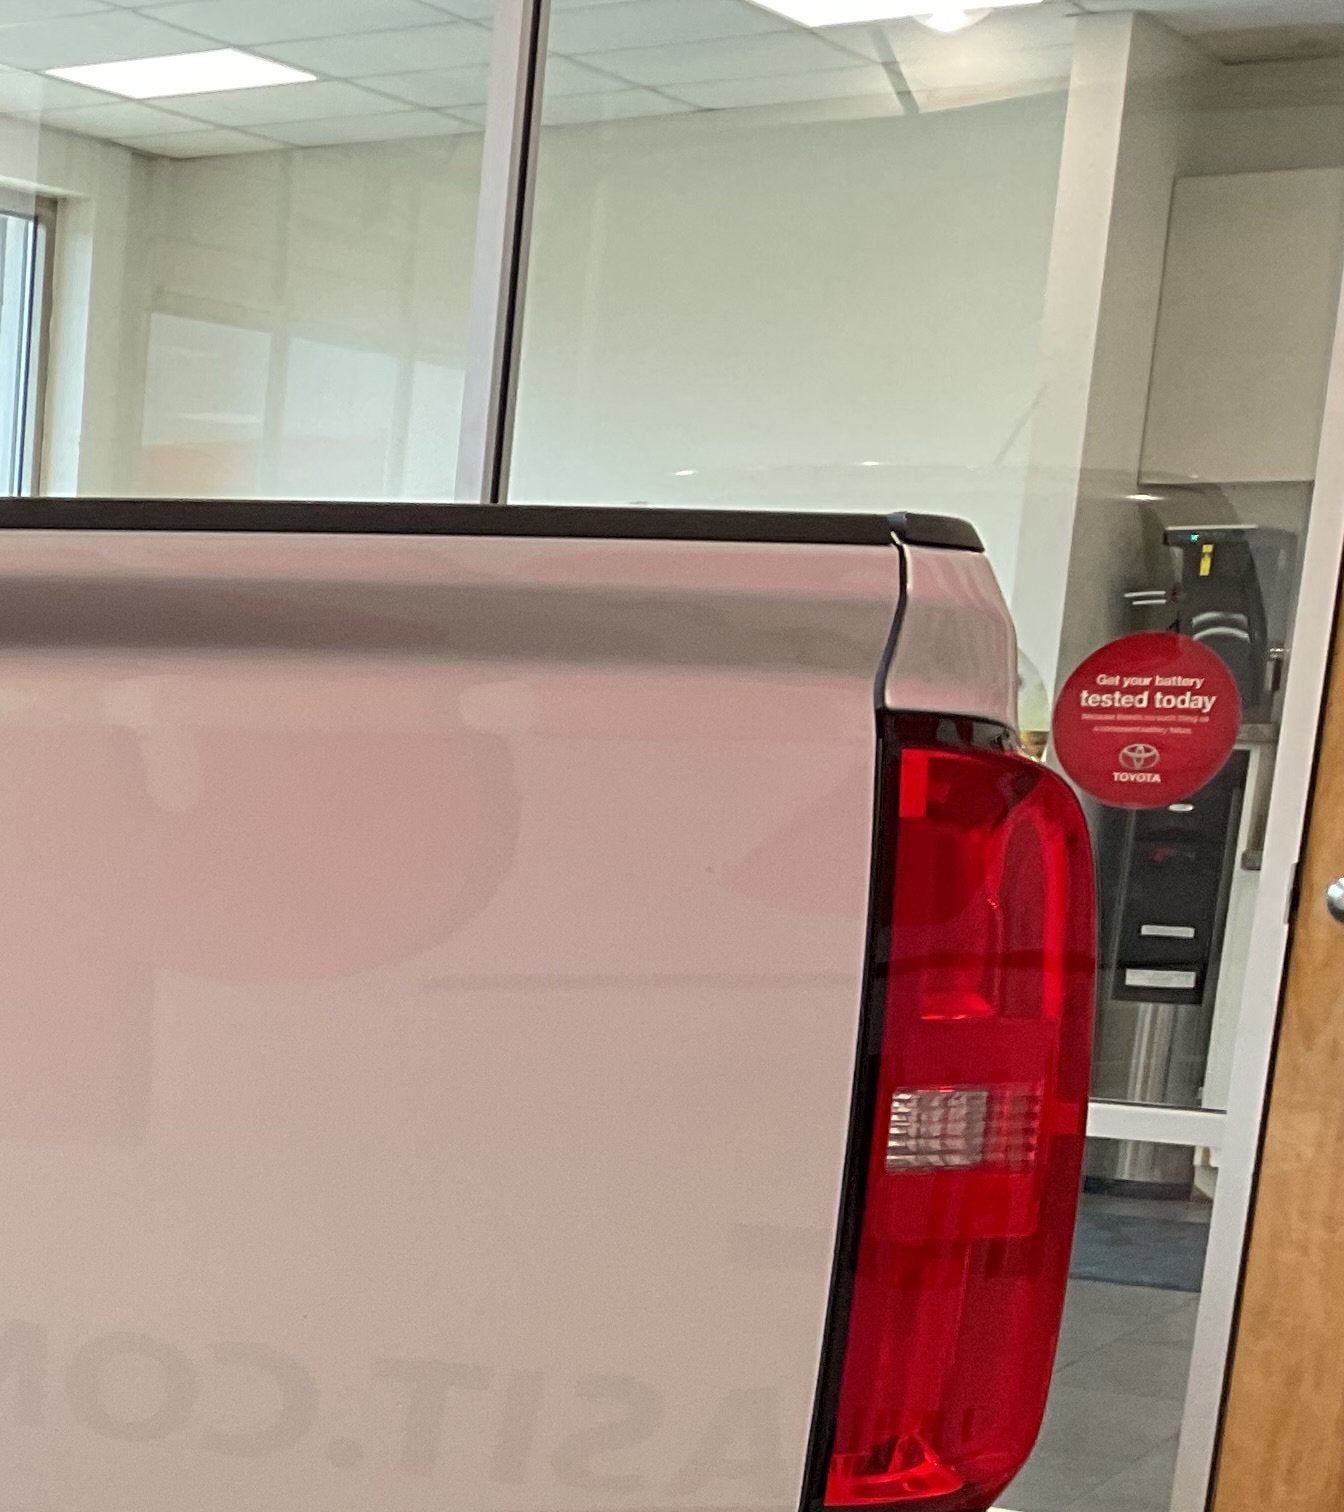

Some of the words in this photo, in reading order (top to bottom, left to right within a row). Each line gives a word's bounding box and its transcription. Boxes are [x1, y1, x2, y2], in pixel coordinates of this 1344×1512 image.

[1096, 674, 1120, 686] Get
[1122, 677, 1152, 688] your
[1155, 675, 1205, 689] battery
[1080, 690, 1150, 708] tested
[1154, 691, 1217, 713] today
[1112, 771, 1161, 783] TOYOTA
